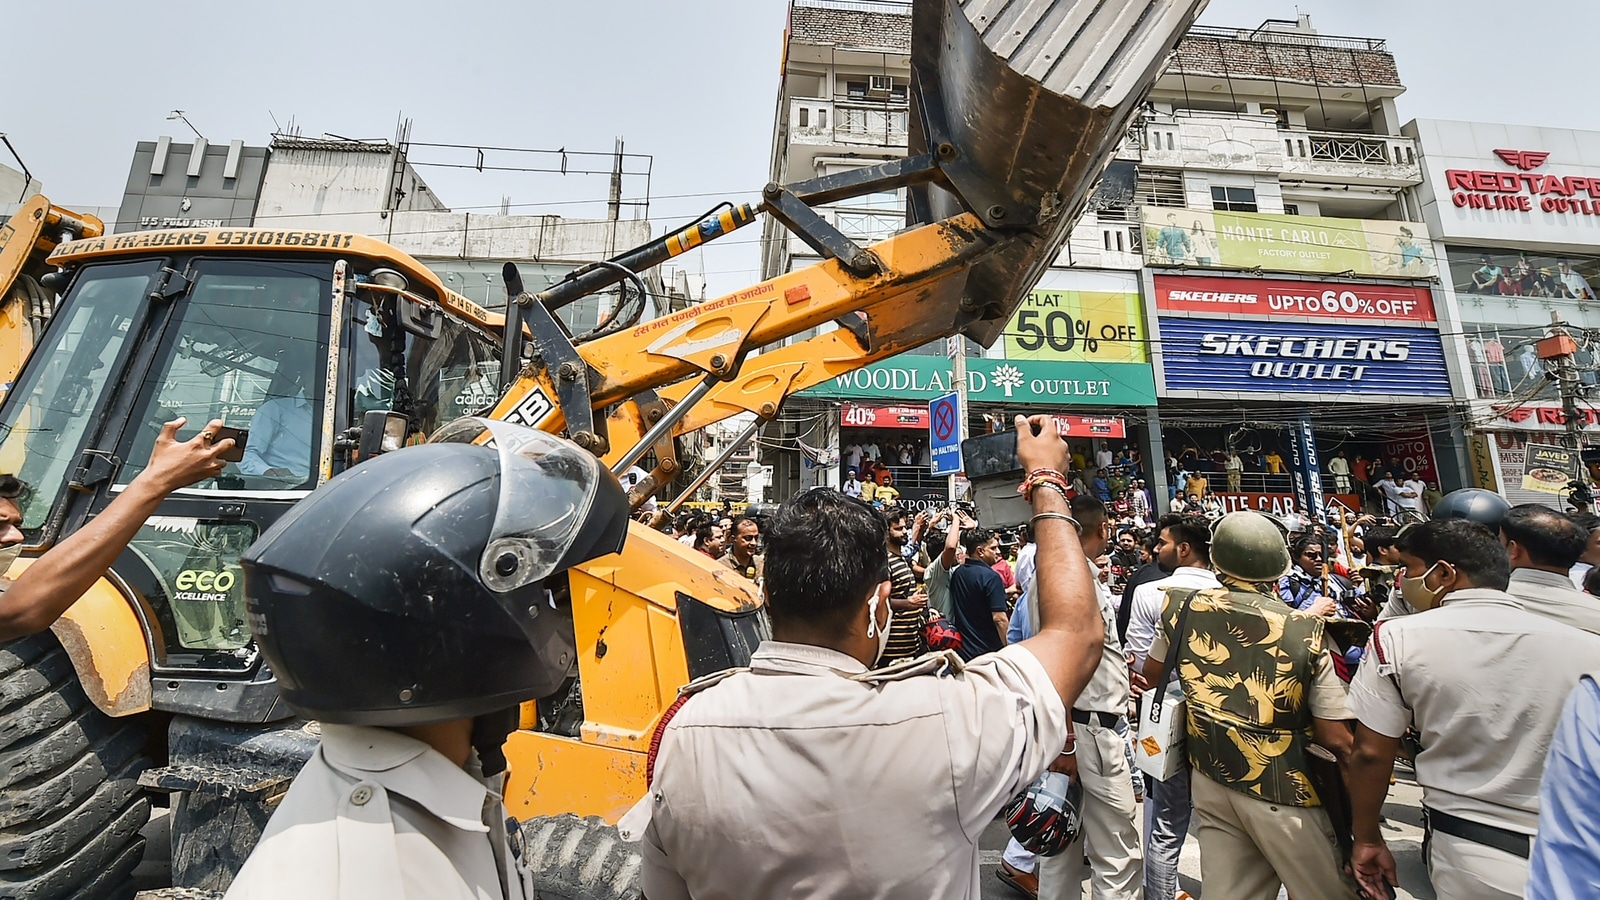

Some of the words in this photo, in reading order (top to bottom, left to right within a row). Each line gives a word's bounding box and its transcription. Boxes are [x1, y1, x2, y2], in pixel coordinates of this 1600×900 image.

[1452, 192, 1532, 211] ONLINE
[162, 217, 190, 226] POLO
[113, 232, 208, 249] TRADERS
[1222, 225, 1274, 243] MONTE
[1281, 229, 1329, 246] CARLO
[1258, 249, 1297, 258] FACTORY
[1298, 251, 1331, 259] OUTLET
[1168, 290, 1258, 304] SKECHERS
[1267, 294, 1320, 312] UPTO
[1321, 290, 1375, 314] 60%
[1016, 310, 1098, 353] 50%
[1100, 325, 1136, 340] OFF
[1199, 333, 1410, 361] SKECHERS
[1250, 361, 1369, 380] OUTLET
[1030, 379, 1111, 396] OUTLET
[455, 393, 498, 406] adida
[845, 406, 876, 425] 40%
[1052, 418, 1070, 434] 0%
[932, 448, 938, 456] NO
[938, 444, 958, 455] HALTING
[1302, 420, 1316, 466] OUTLET
[1386, 441, 1425, 455] UPTO
[1403, 455, 1428, 473] 0%
[1535, 450, 1570, 460] JAVED
[897, 499, 946, 512] XPORT
[1215, 495, 1249, 515] NTE
[1258, 495, 1295, 515] CAR
[1309, 470, 1326, 524] CHERS
[175, 569, 235, 592] eco
[173, 592, 227, 601] XCELLENCE
